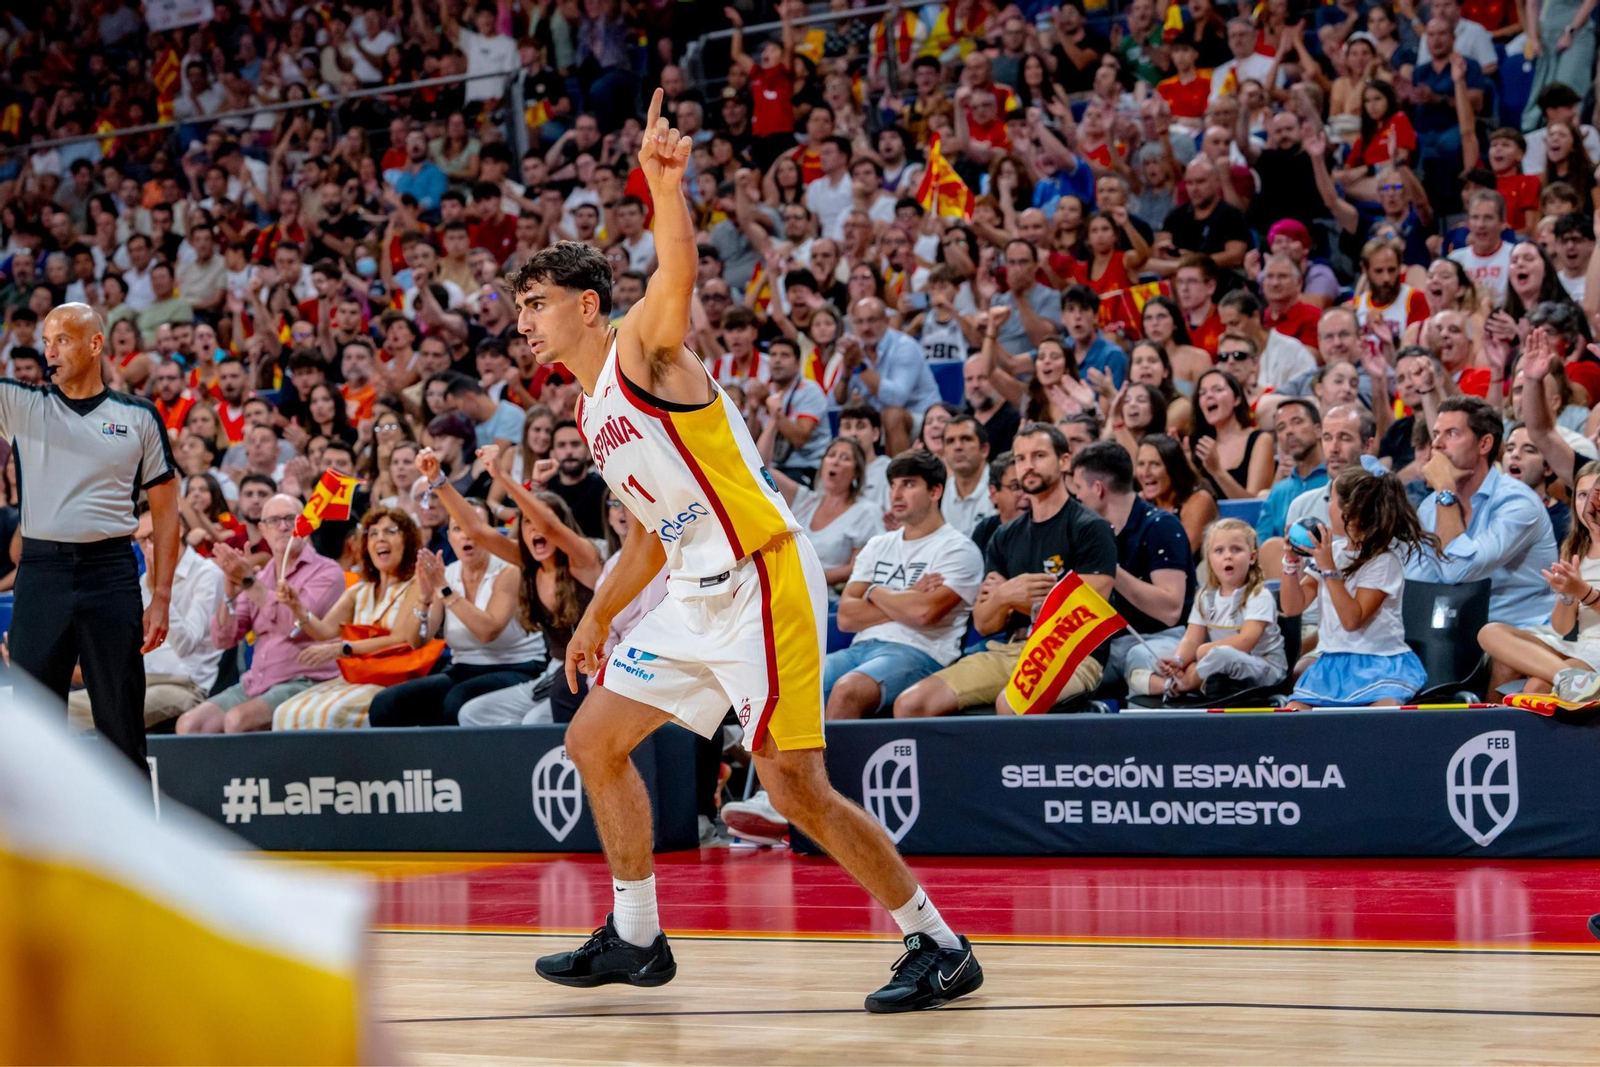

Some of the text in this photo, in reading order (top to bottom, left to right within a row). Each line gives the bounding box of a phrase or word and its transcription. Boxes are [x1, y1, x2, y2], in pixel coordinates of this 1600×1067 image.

[592, 415, 644, 477] SPAÑA
[873, 561, 928, 587] EA7
[1014, 604, 1100, 701] ESPAÑA
[894, 746, 912, 757] FEB
[1487, 737, 1510, 750] FEB
[1001, 755, 1346, 788] SELECCIÓN ESPAÑOLA
[221, 769, 463, 824] #LaFamilia
[1044, 800, 1301, 826] DE BALONCESTO
